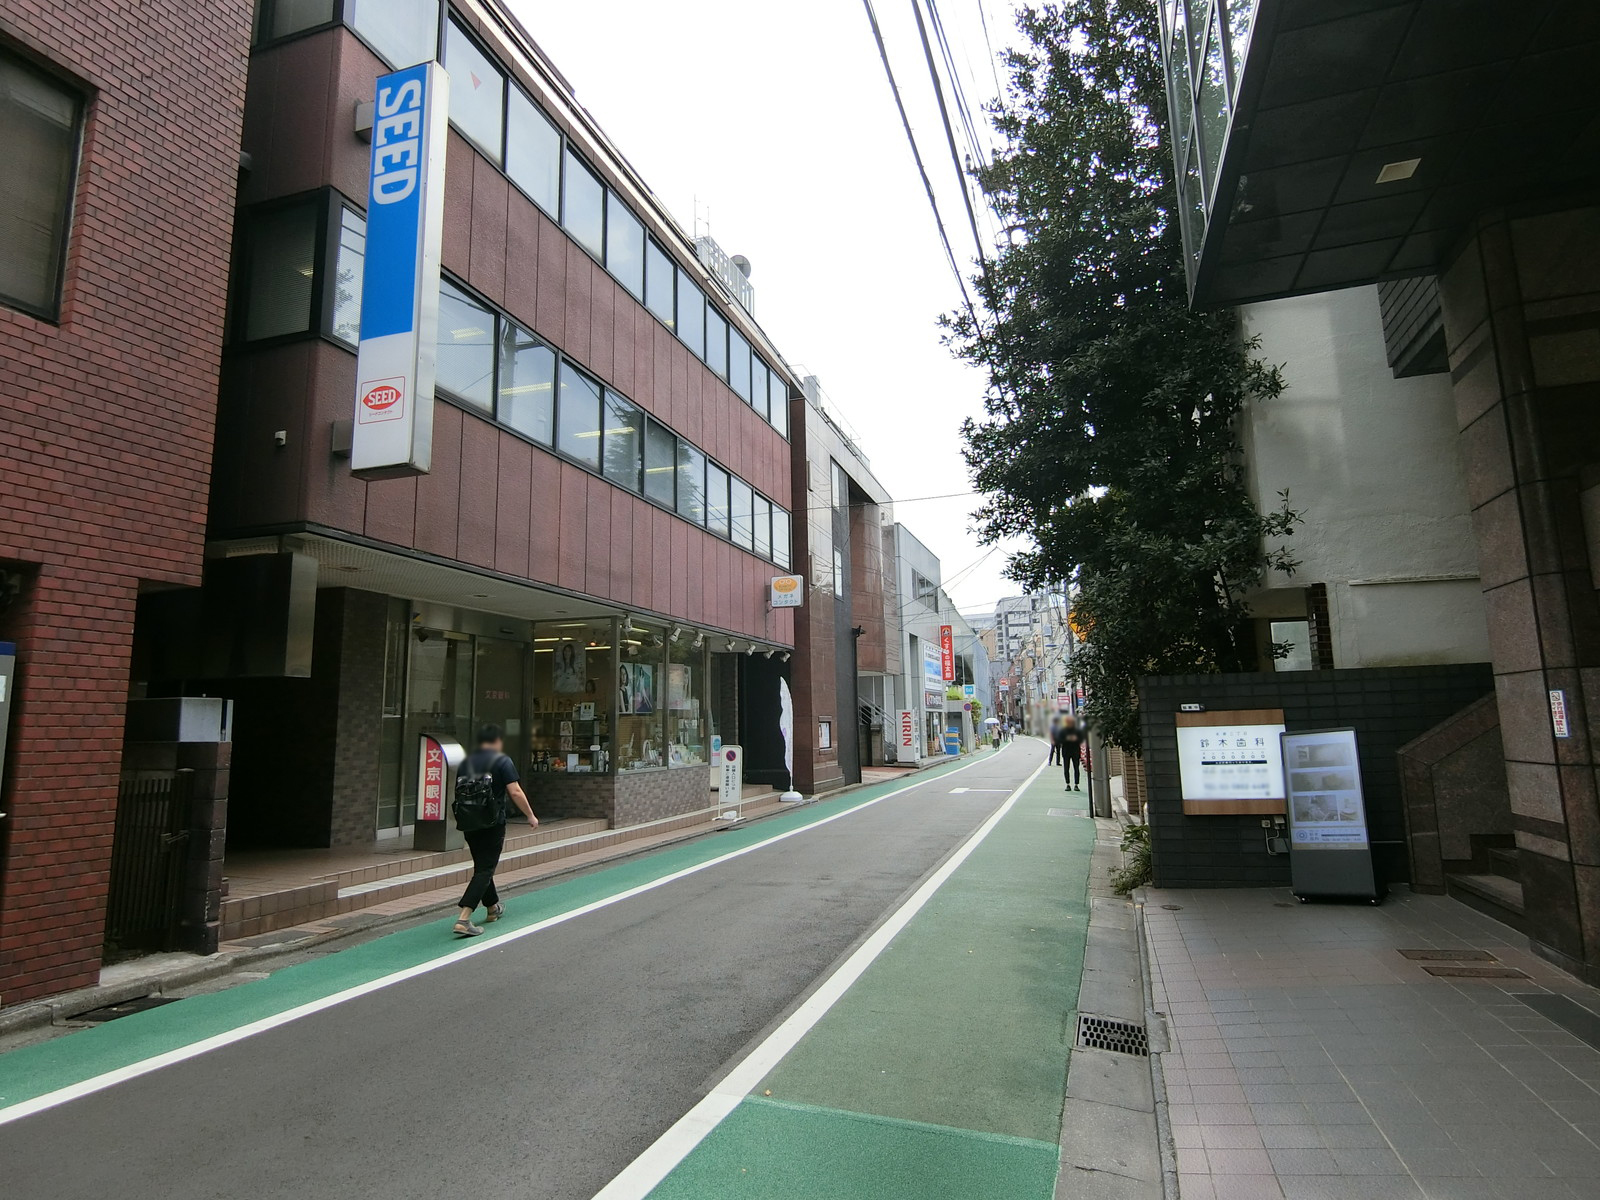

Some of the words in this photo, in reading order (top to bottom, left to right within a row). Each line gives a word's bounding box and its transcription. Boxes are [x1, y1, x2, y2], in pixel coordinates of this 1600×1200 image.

[373, 79, 421, 205] SEED
[368, 389, 396, 406] SEED
[902, 712, 912, 746] KIRIN
[1200, 737, 1264, 748] 鈴木歯科
[425, 749, 442, 817] 文京眼科
